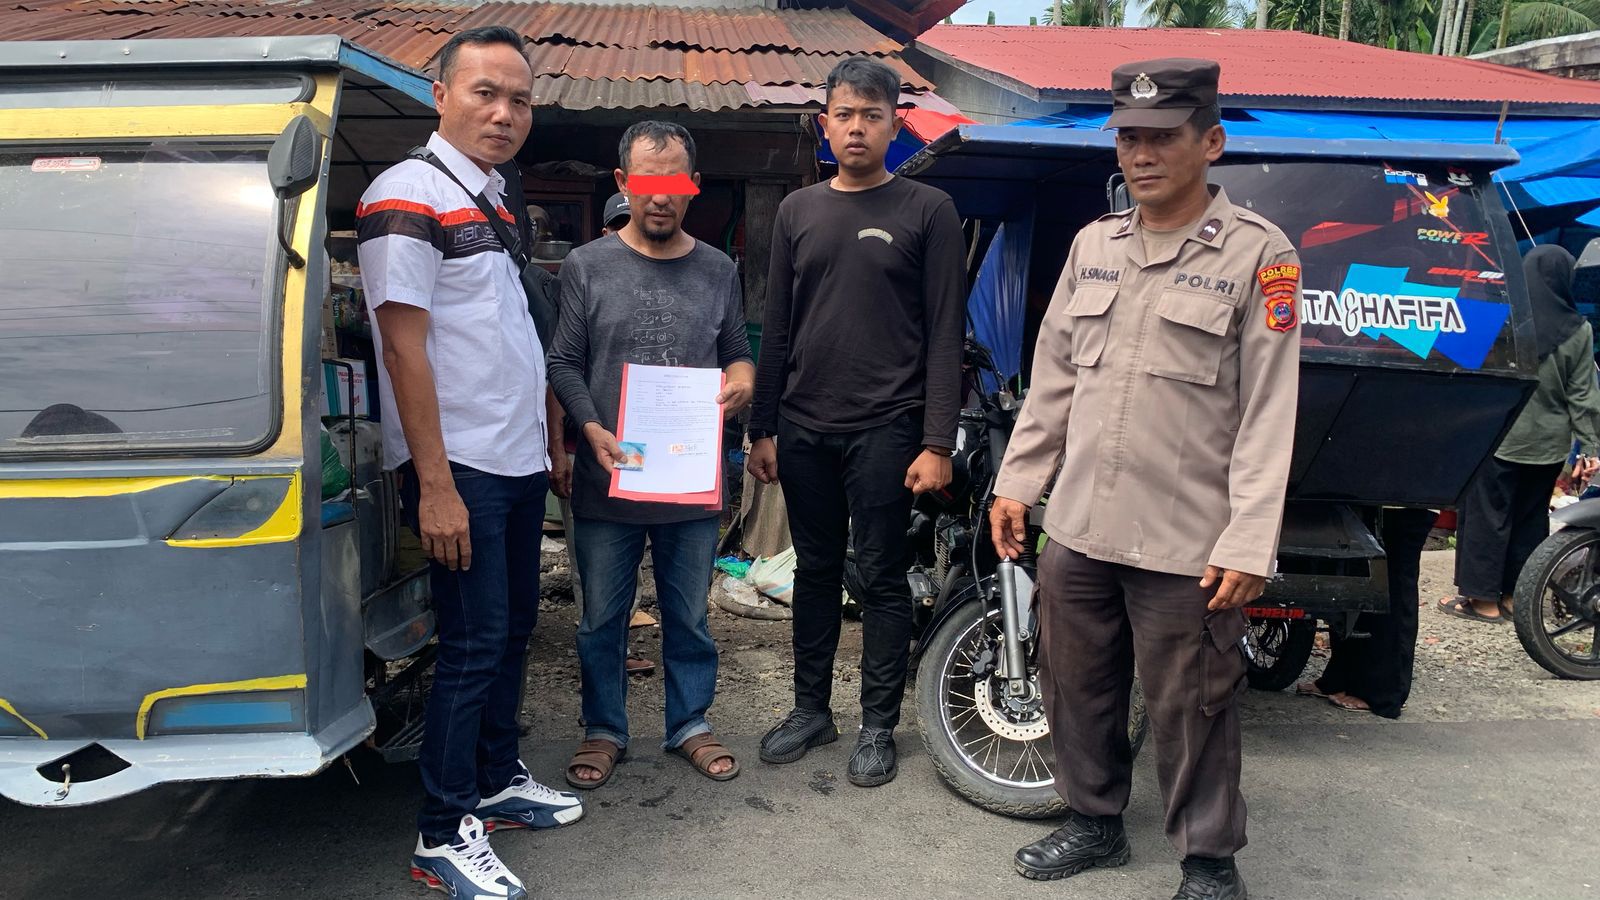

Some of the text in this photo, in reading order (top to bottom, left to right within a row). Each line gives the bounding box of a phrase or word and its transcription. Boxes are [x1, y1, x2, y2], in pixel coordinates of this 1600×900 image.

[1384, 169, 1426, 180] GoPro
[1417, 228, 1490, 245] POWER
[1260, 266, 1298, 279] POLRES
[1174, 272, 1236, 296] POLRI
[1302, 289, 1465, 334] TA&HAFIFA
